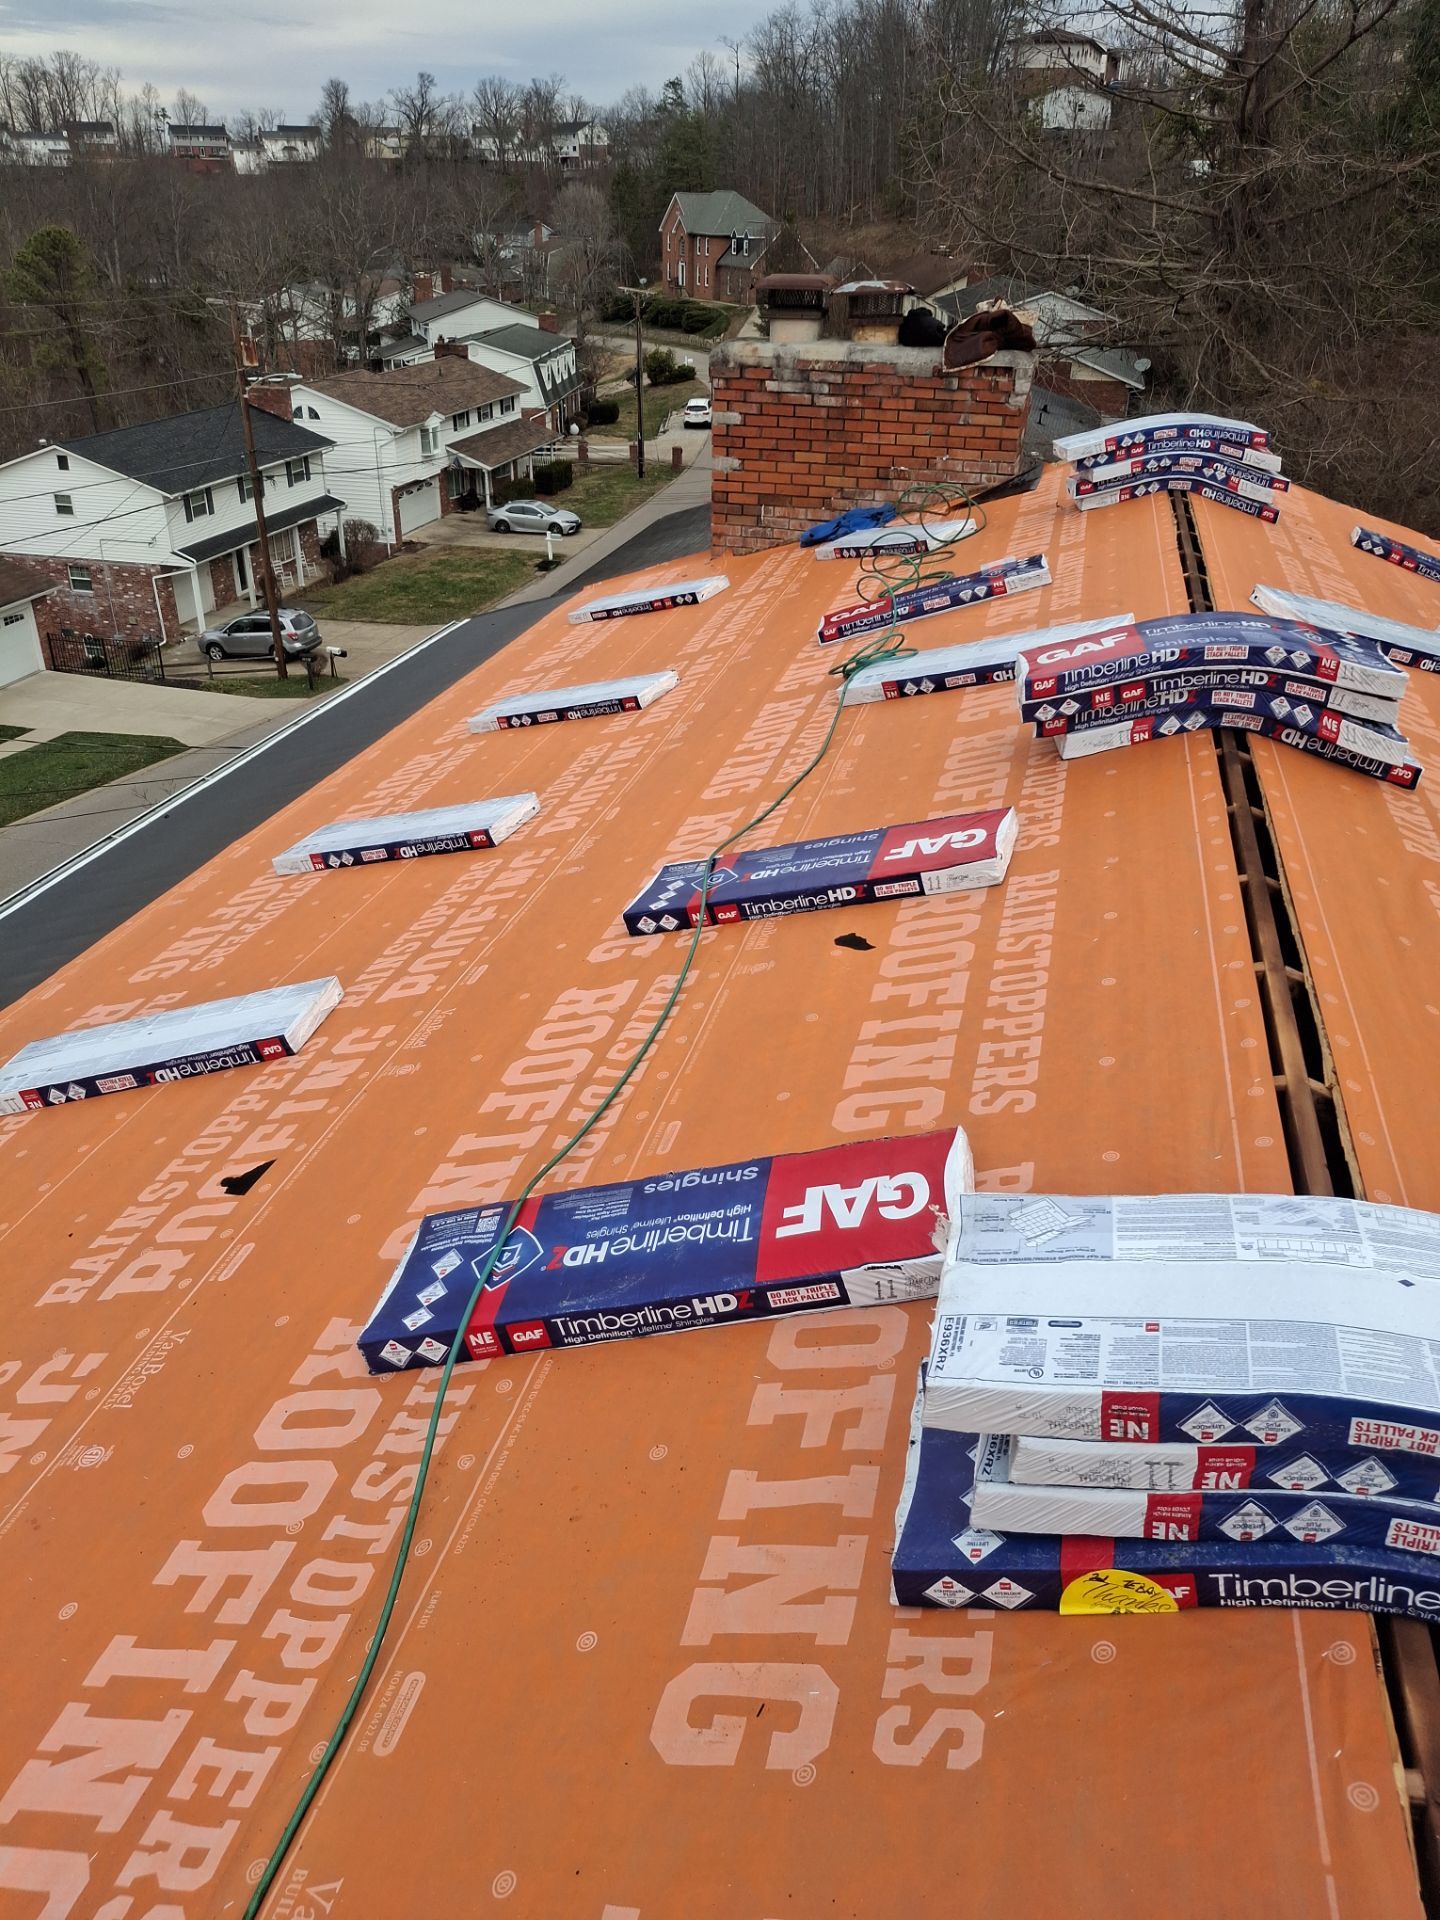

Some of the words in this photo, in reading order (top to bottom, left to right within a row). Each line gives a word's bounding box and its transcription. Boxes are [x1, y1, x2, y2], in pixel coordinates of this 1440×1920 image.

[1147, 439, 1195, 450] Timberline
[1080, 483, 1093, 491] GAF
[1392, 552, 1400, 560] NE
[1403, 560, 1415, 568] GAF
[831, 601, 887, 621] GAF
[824, 628, 836, 636] GAF
[1037, 632, 1128, 664] GAF
[1033, 678, 1055, 691] GAF
[1063, 652, 1150, 684] Timberline
[1151, 648, 1188, 663] HDZ
[1321, 656, 1337, 669] NE
[1064, 683, 1079, 692] High
[1095, 691, 1111, 703] NE
[1122, 688, 1144, 699] GAF
[1151, 669, 1240, 692] Timberline
[1241, 670, 1278, 688] HDZ
[1045, 719, 1066, 730] GAF
[1322, 715, 1339, 732] NE
[1133, 731, 1149, 742] NE
[1307, 737, 1386, 778] Timberline
[1390, 767, 1413, 780] GAF
[416, 837, 470, 854] Timberline
[472, 834, 486, 843] GAF
[804, 833, 879, 851] Shingles
[884, 829, 987, 862] GAF
[741, 868, 779, 882] HDZ
[777, 854, 871, 877] Timberline
[927, 876, 941, 891] 11
[718, 910, 737, 920] GAF
[742, 892, 828, 915] Timberline
[828, 885, 866, 902] HDZ
[375, 848, 557, 1004] ROOFING
[968, 869, 1060, 1116] RAINSTOPPERS
[832, 886, 988, 1133] ROOFING
[263, 1046, 282, 1056] GAF
[180, 1049, 260, 1076] Timberline
[28, 1100, 42, 1109] NE
[36, 1036, 329, 1307] RAINSTOPPERS
[97, 1024, 398, 1301] ROOFING
[644, 1166, 759, 1195] Shingles
[729, 1203, 751, 1214] High
[775, 1171, 930, 1239] GAF
[635, 1214, 676, 1229] Lifetime
[677, 1207, 725, 1223] Definition
[586, 1221, 628, 1240] Shingles
[610, 1216, 754, 1257] Timberline
[546, 1239, 608, 1271] HDZ
[770, 1290, 783, 1299] DO
[786, 1288, 802, 1297] NOT
[807, 1284, 835, 1295] TRIPLE
[771, 1296, 798, 1307] STACK
[801, 1290, 838, 1302] PALLETS
[874, 1279, 898, 1301] 11
[469, 1330, 495, 1347] NE
[513, 1328, 544, 1343] GAF
[551, 1300, 693, 1336] Timberline
[694, 1291, 754, 1316] HDZ
[564, 1334, 586, 1344] High
[587, 1328, 632, 1343] Definition
[637, 1321, 671, 1336] Lifetime
[675, 1315, 715, 1329] Shingles
[934, 1317, 955, 1372] E936XRZ
[1110, 1418, 1149, 1440] NE
[1355, 1421, 1417, 1439] PALLETS
[1353, 1432, 1400, 1448] TRIPLE
[1407, 1440, 1437, 1455] NOT
[1144, 1460, 1185, 1491] 11
[1200, 1471, 1243, 1490] NE
[650, 1303, 912, 1771] OFING
[1151, 1521, 1190, 1541] NE
[1395, 1521, 1440, 1540] ALLETS
[1390, 1533, 1439, 1552] TRIPLE
[1208, 1573, 1440, 1609] Timberline
[1220, 1598, 1258, 1608] High
[1260, 1598, 1336, 1609] Definition
[1344, 1601, 1404, 1615] Lifetime
